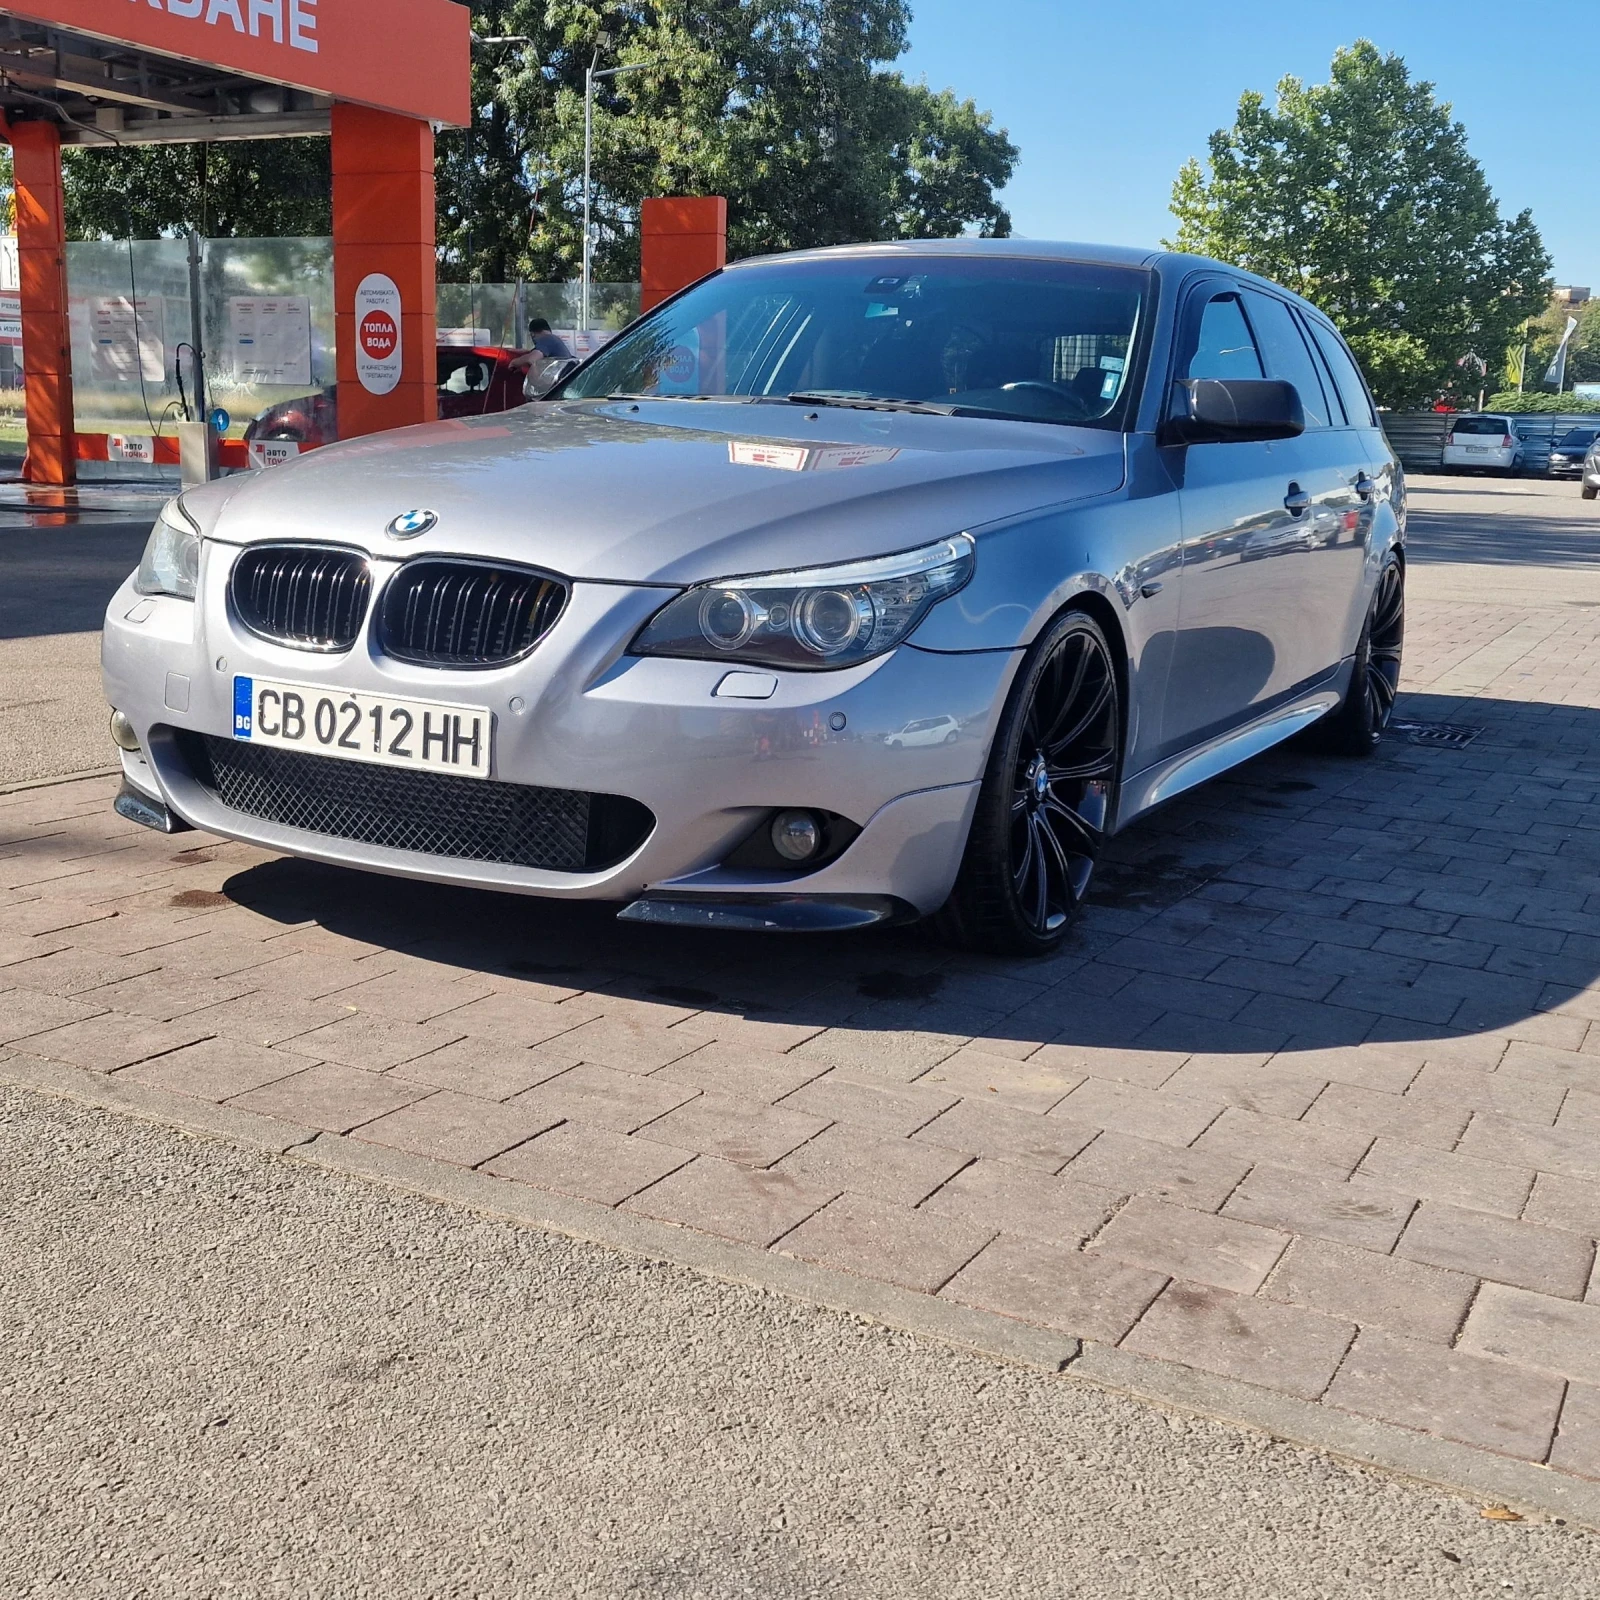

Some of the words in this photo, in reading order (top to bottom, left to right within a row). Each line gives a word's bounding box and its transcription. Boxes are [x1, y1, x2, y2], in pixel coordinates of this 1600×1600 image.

[364, 323, 393, 333] ТОПЛА
[366, 337, 391, 349] ВОДА
[235, 714, 251, 730] BG
[314, 697, 414, 758] 0212
